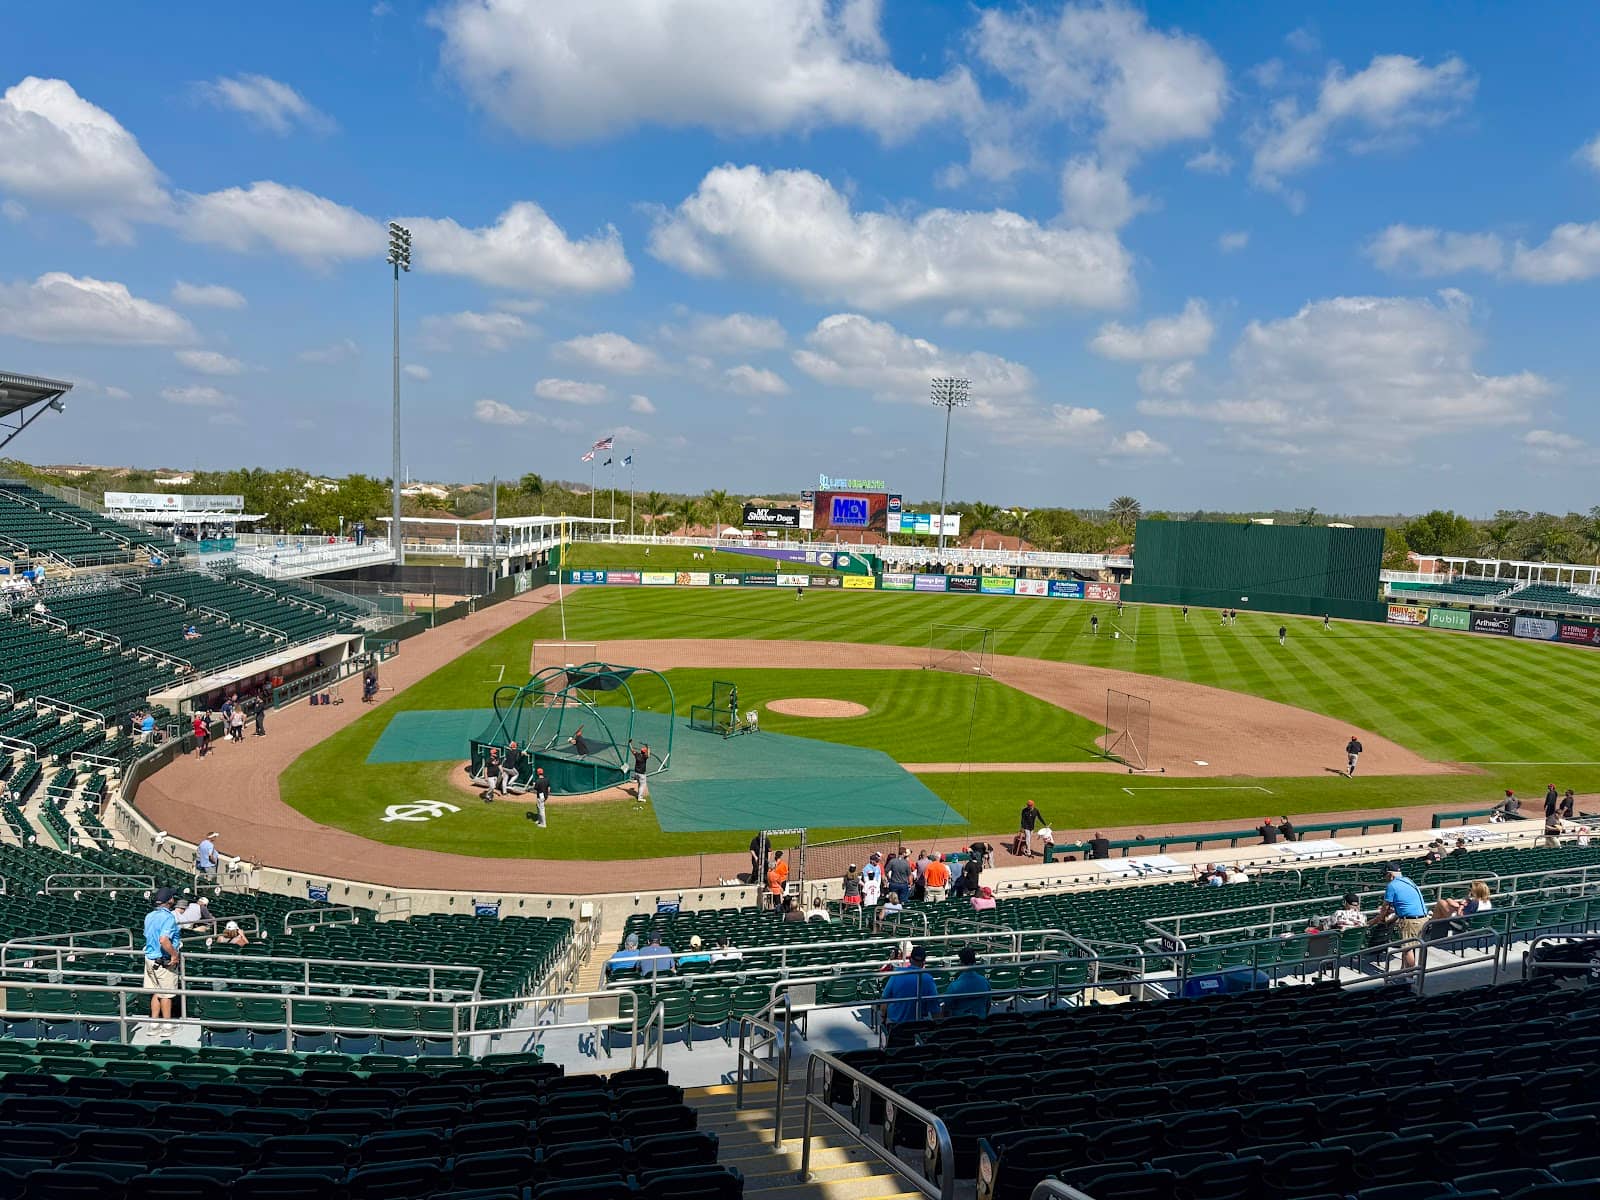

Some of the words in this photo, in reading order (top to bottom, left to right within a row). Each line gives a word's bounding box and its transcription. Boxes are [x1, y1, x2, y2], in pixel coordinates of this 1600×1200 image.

[747, 511, 776, 521] Shower
[776, 514, 795, 522] Door
[757, 508, 770, 516] MY
[1432, 614, 1465, 625] Publix
[1475, 618, 1501, 628] Arthrex
[1567, 624, 1588, 633] Hilton
[1163, 938, 1174, 951] 104
